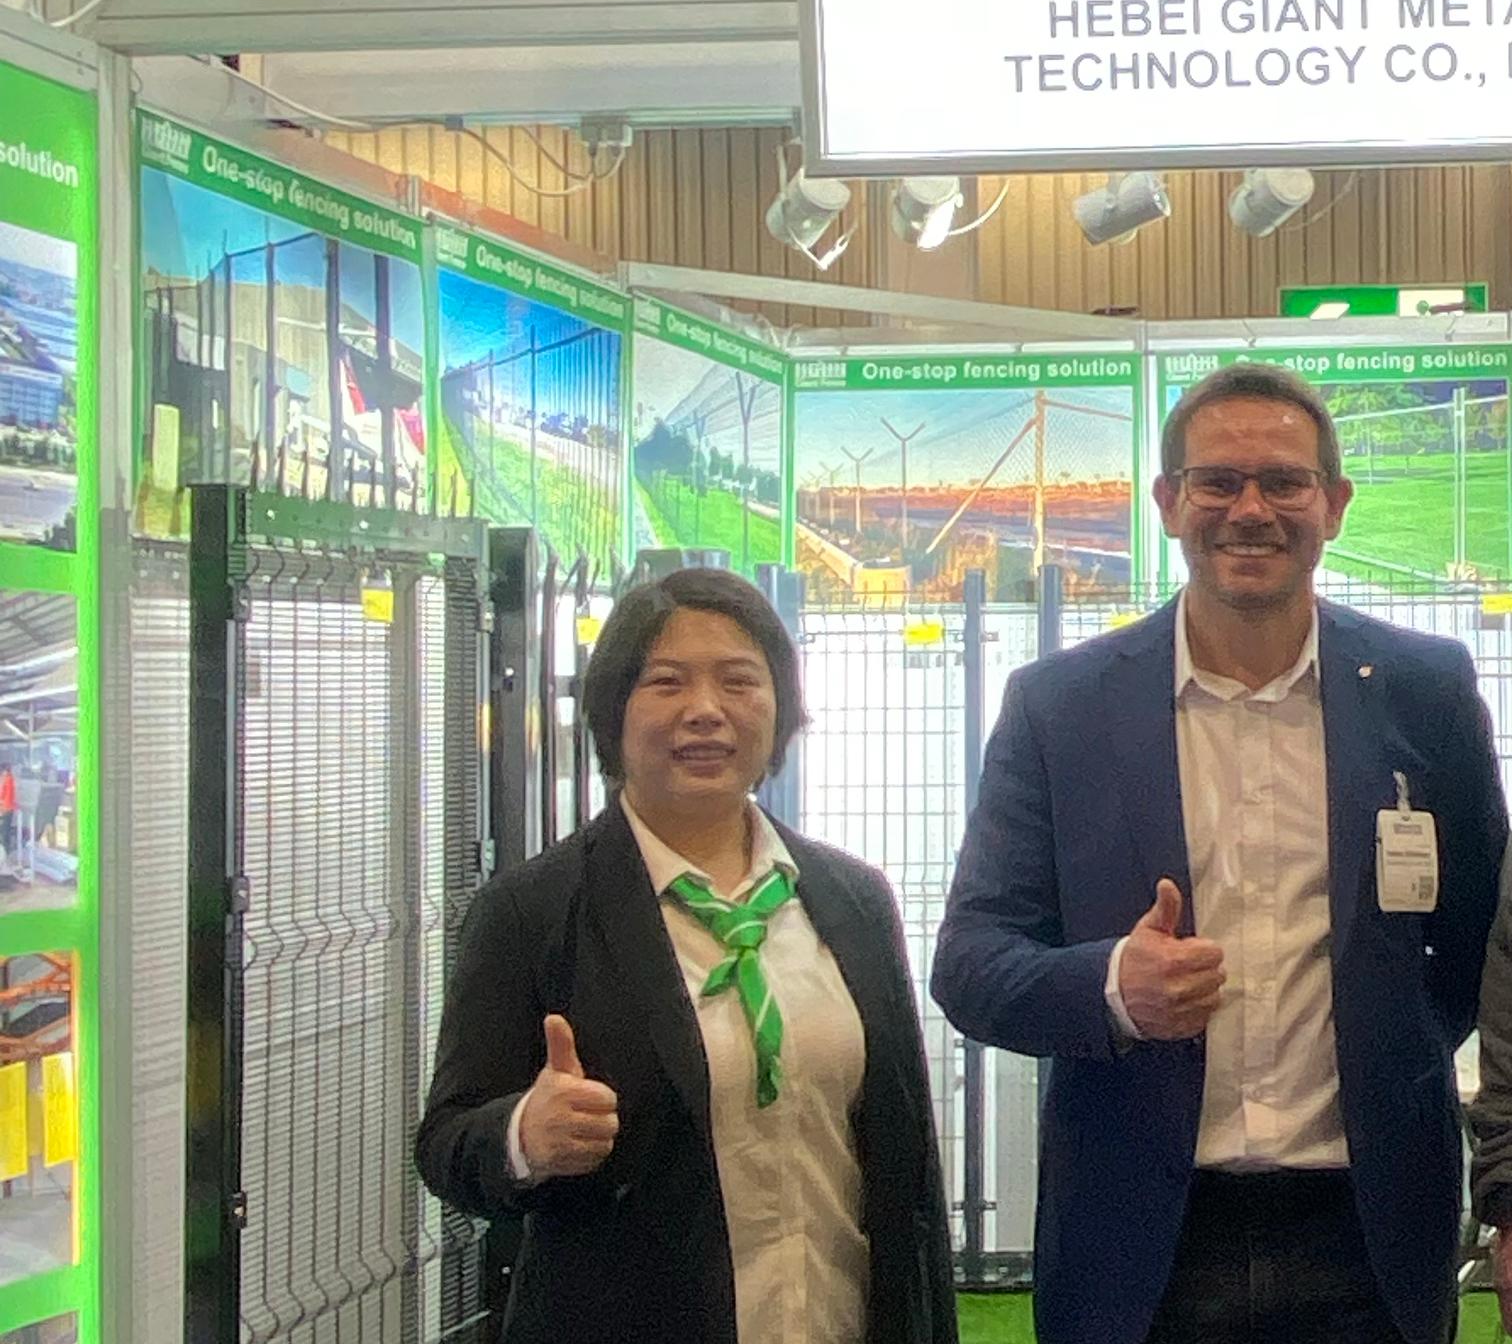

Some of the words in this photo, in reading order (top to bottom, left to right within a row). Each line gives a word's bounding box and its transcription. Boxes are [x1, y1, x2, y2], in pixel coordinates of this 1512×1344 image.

[1004, 45, 1366, 93] TECHNOLOGY
[1385, 43, 1487, 88] CO.,
[0, 142, 79, 188] solution
[202, 145, 284, 202] One-stop
[287, 176, 350, 229] fencing
[353, 210, 416, 249] solution
[862, 360, 957, 382] One-stop
[963, 359, 1041, 382] fencing
[1047, 359, 1133, 377] solution
[1336, 350, 1416, 373] fencing
[1421, 349, 1507, 368] solution
